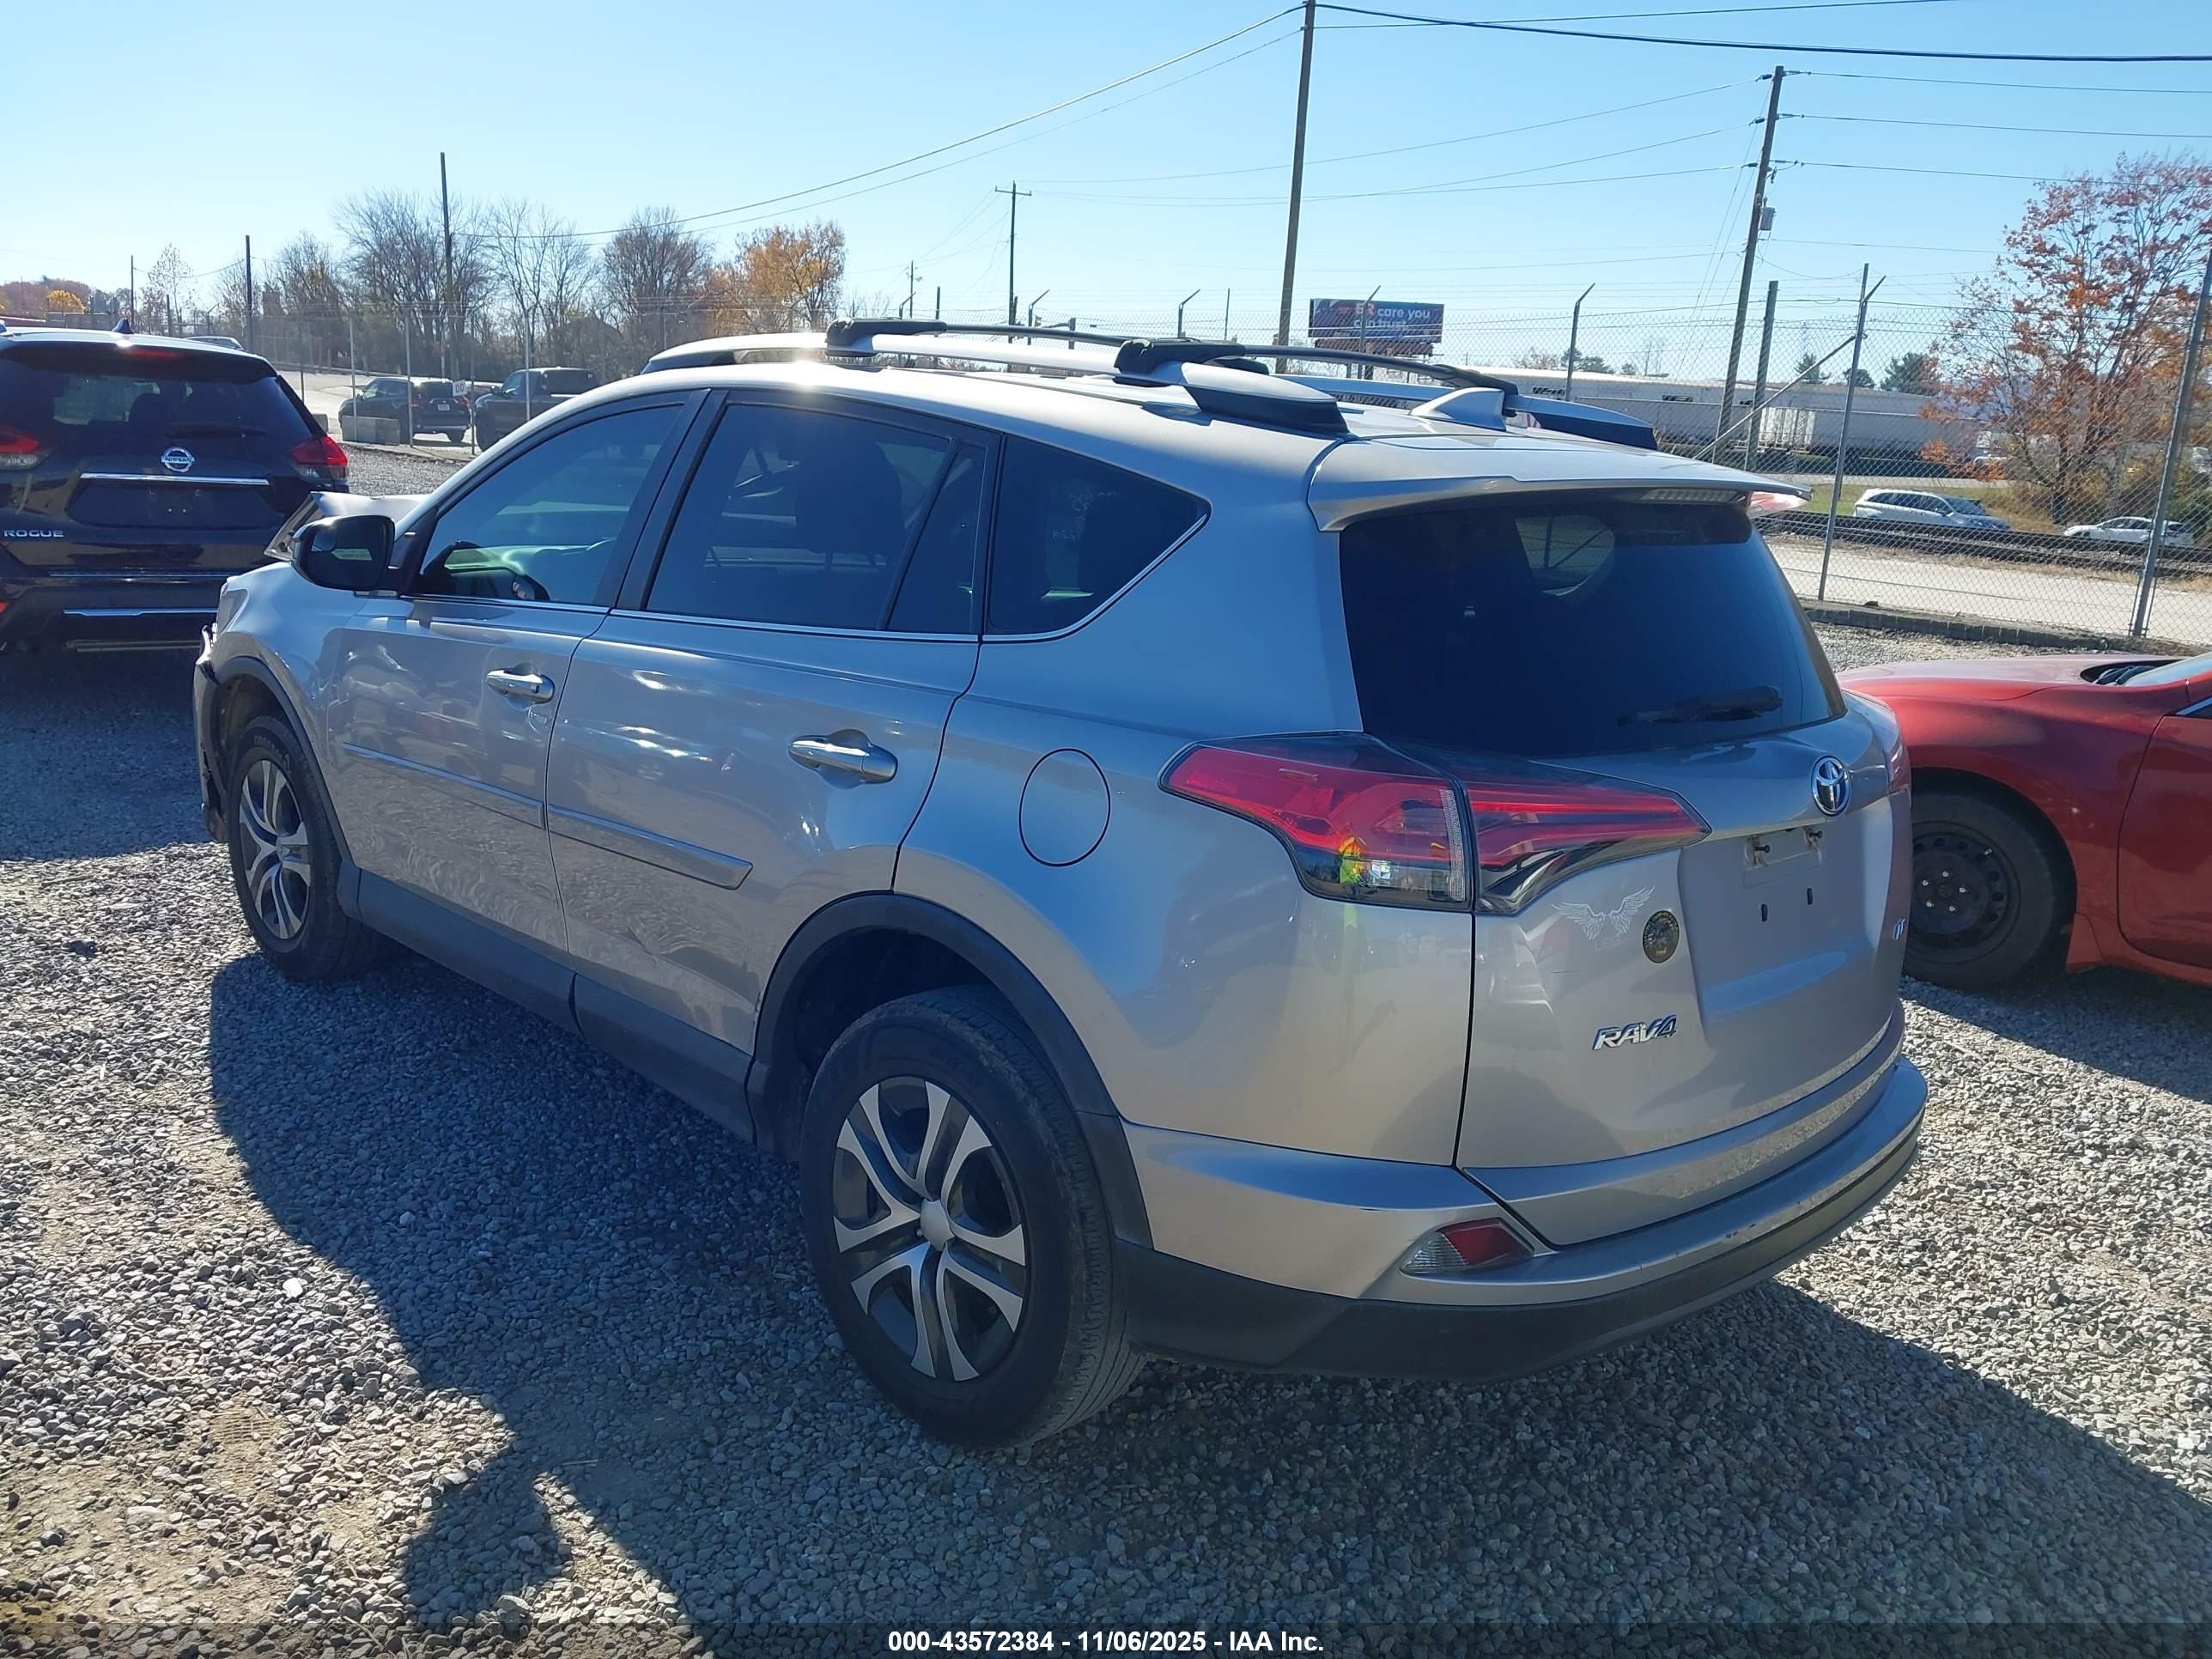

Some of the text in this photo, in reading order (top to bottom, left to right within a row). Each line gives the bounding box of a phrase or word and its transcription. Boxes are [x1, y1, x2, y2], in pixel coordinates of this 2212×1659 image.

[1376, 307, 1405, 318] care
[1407, 308, 1431, 320] you
[3, 529, 65, 538] ROGUE
[1592, 1014, 1678, 1051] RAV4
